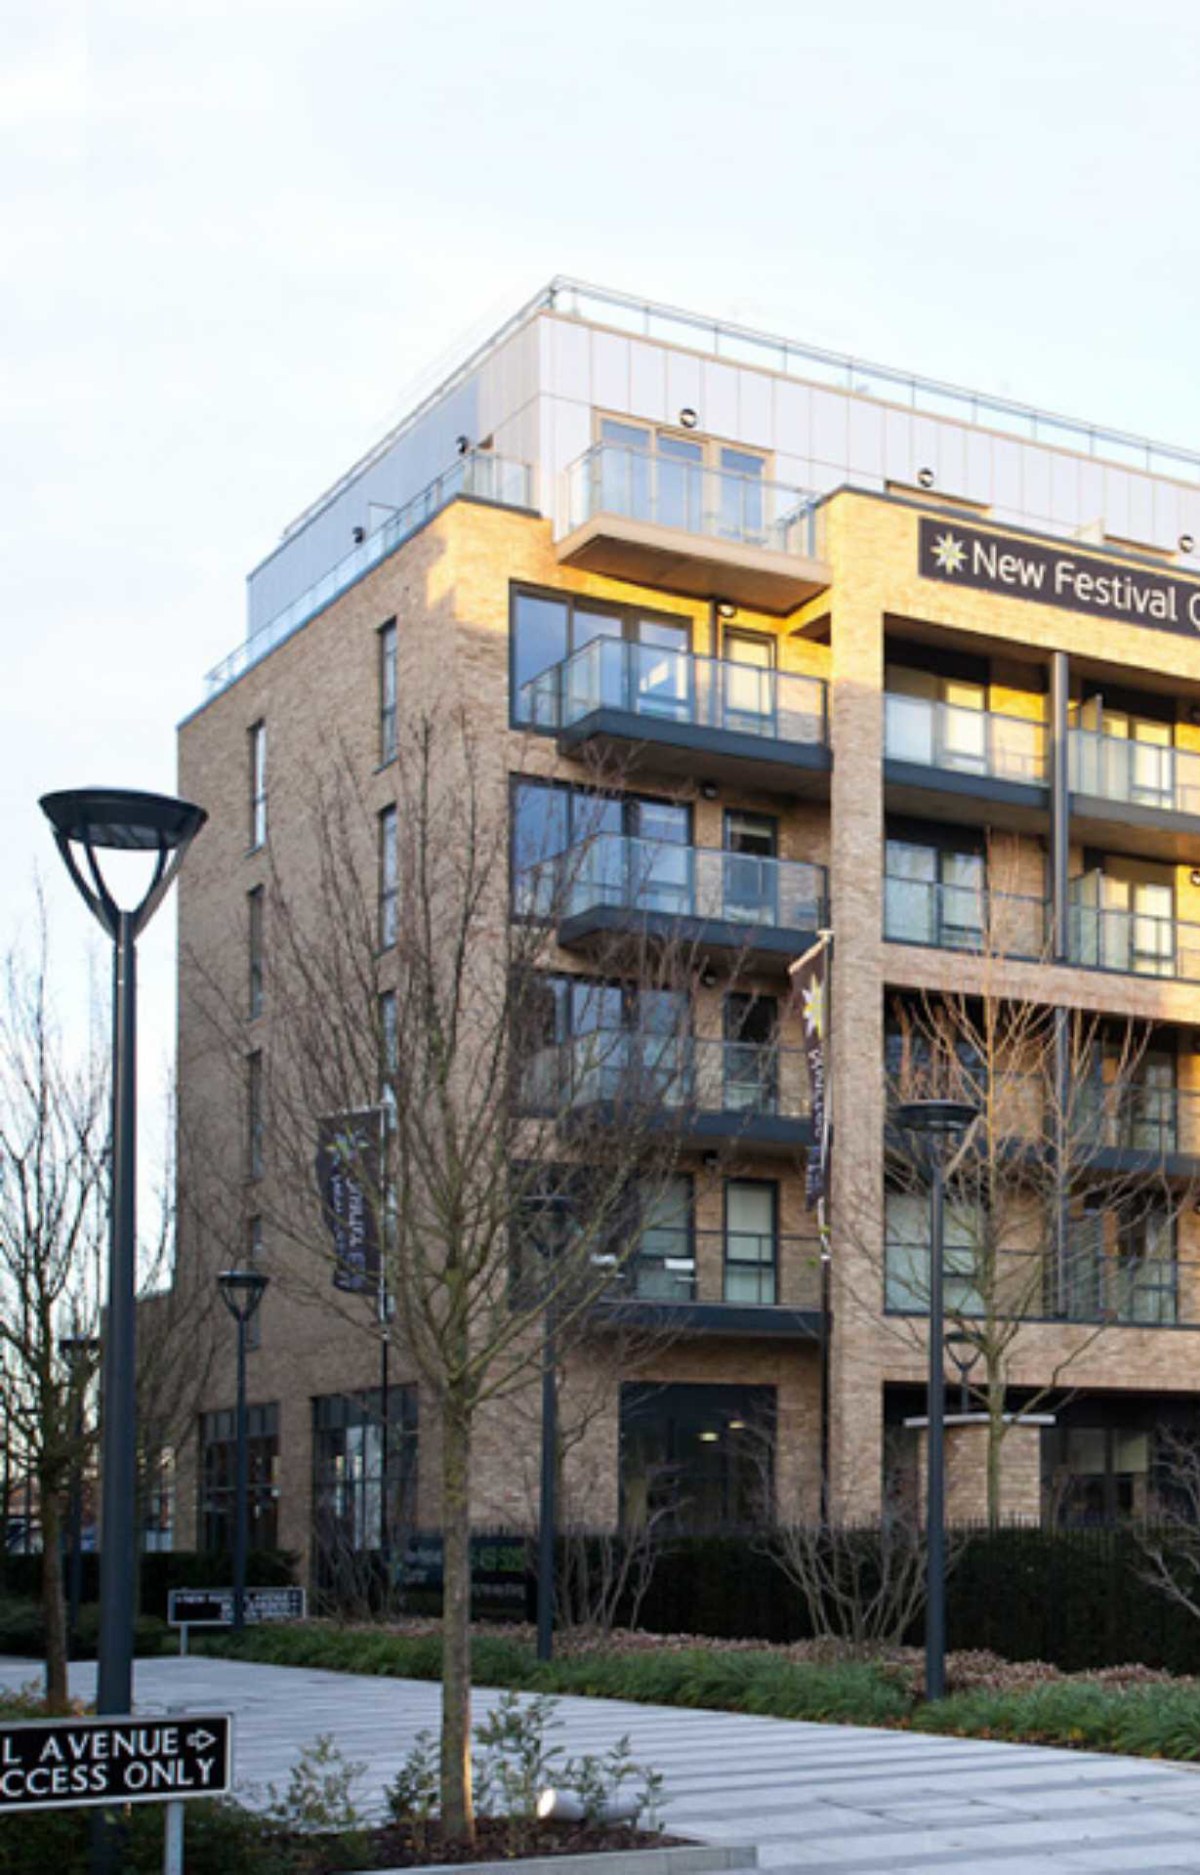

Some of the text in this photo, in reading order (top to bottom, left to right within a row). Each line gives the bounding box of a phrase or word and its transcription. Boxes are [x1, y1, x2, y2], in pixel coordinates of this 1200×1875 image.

[973, 541, 1045, 588] New
[1054, 561, 1178, 622] Festival
[39, 1727, 179, 1763] AVENUE
[1, 1757, 215, 1798] CCESS ONLY
